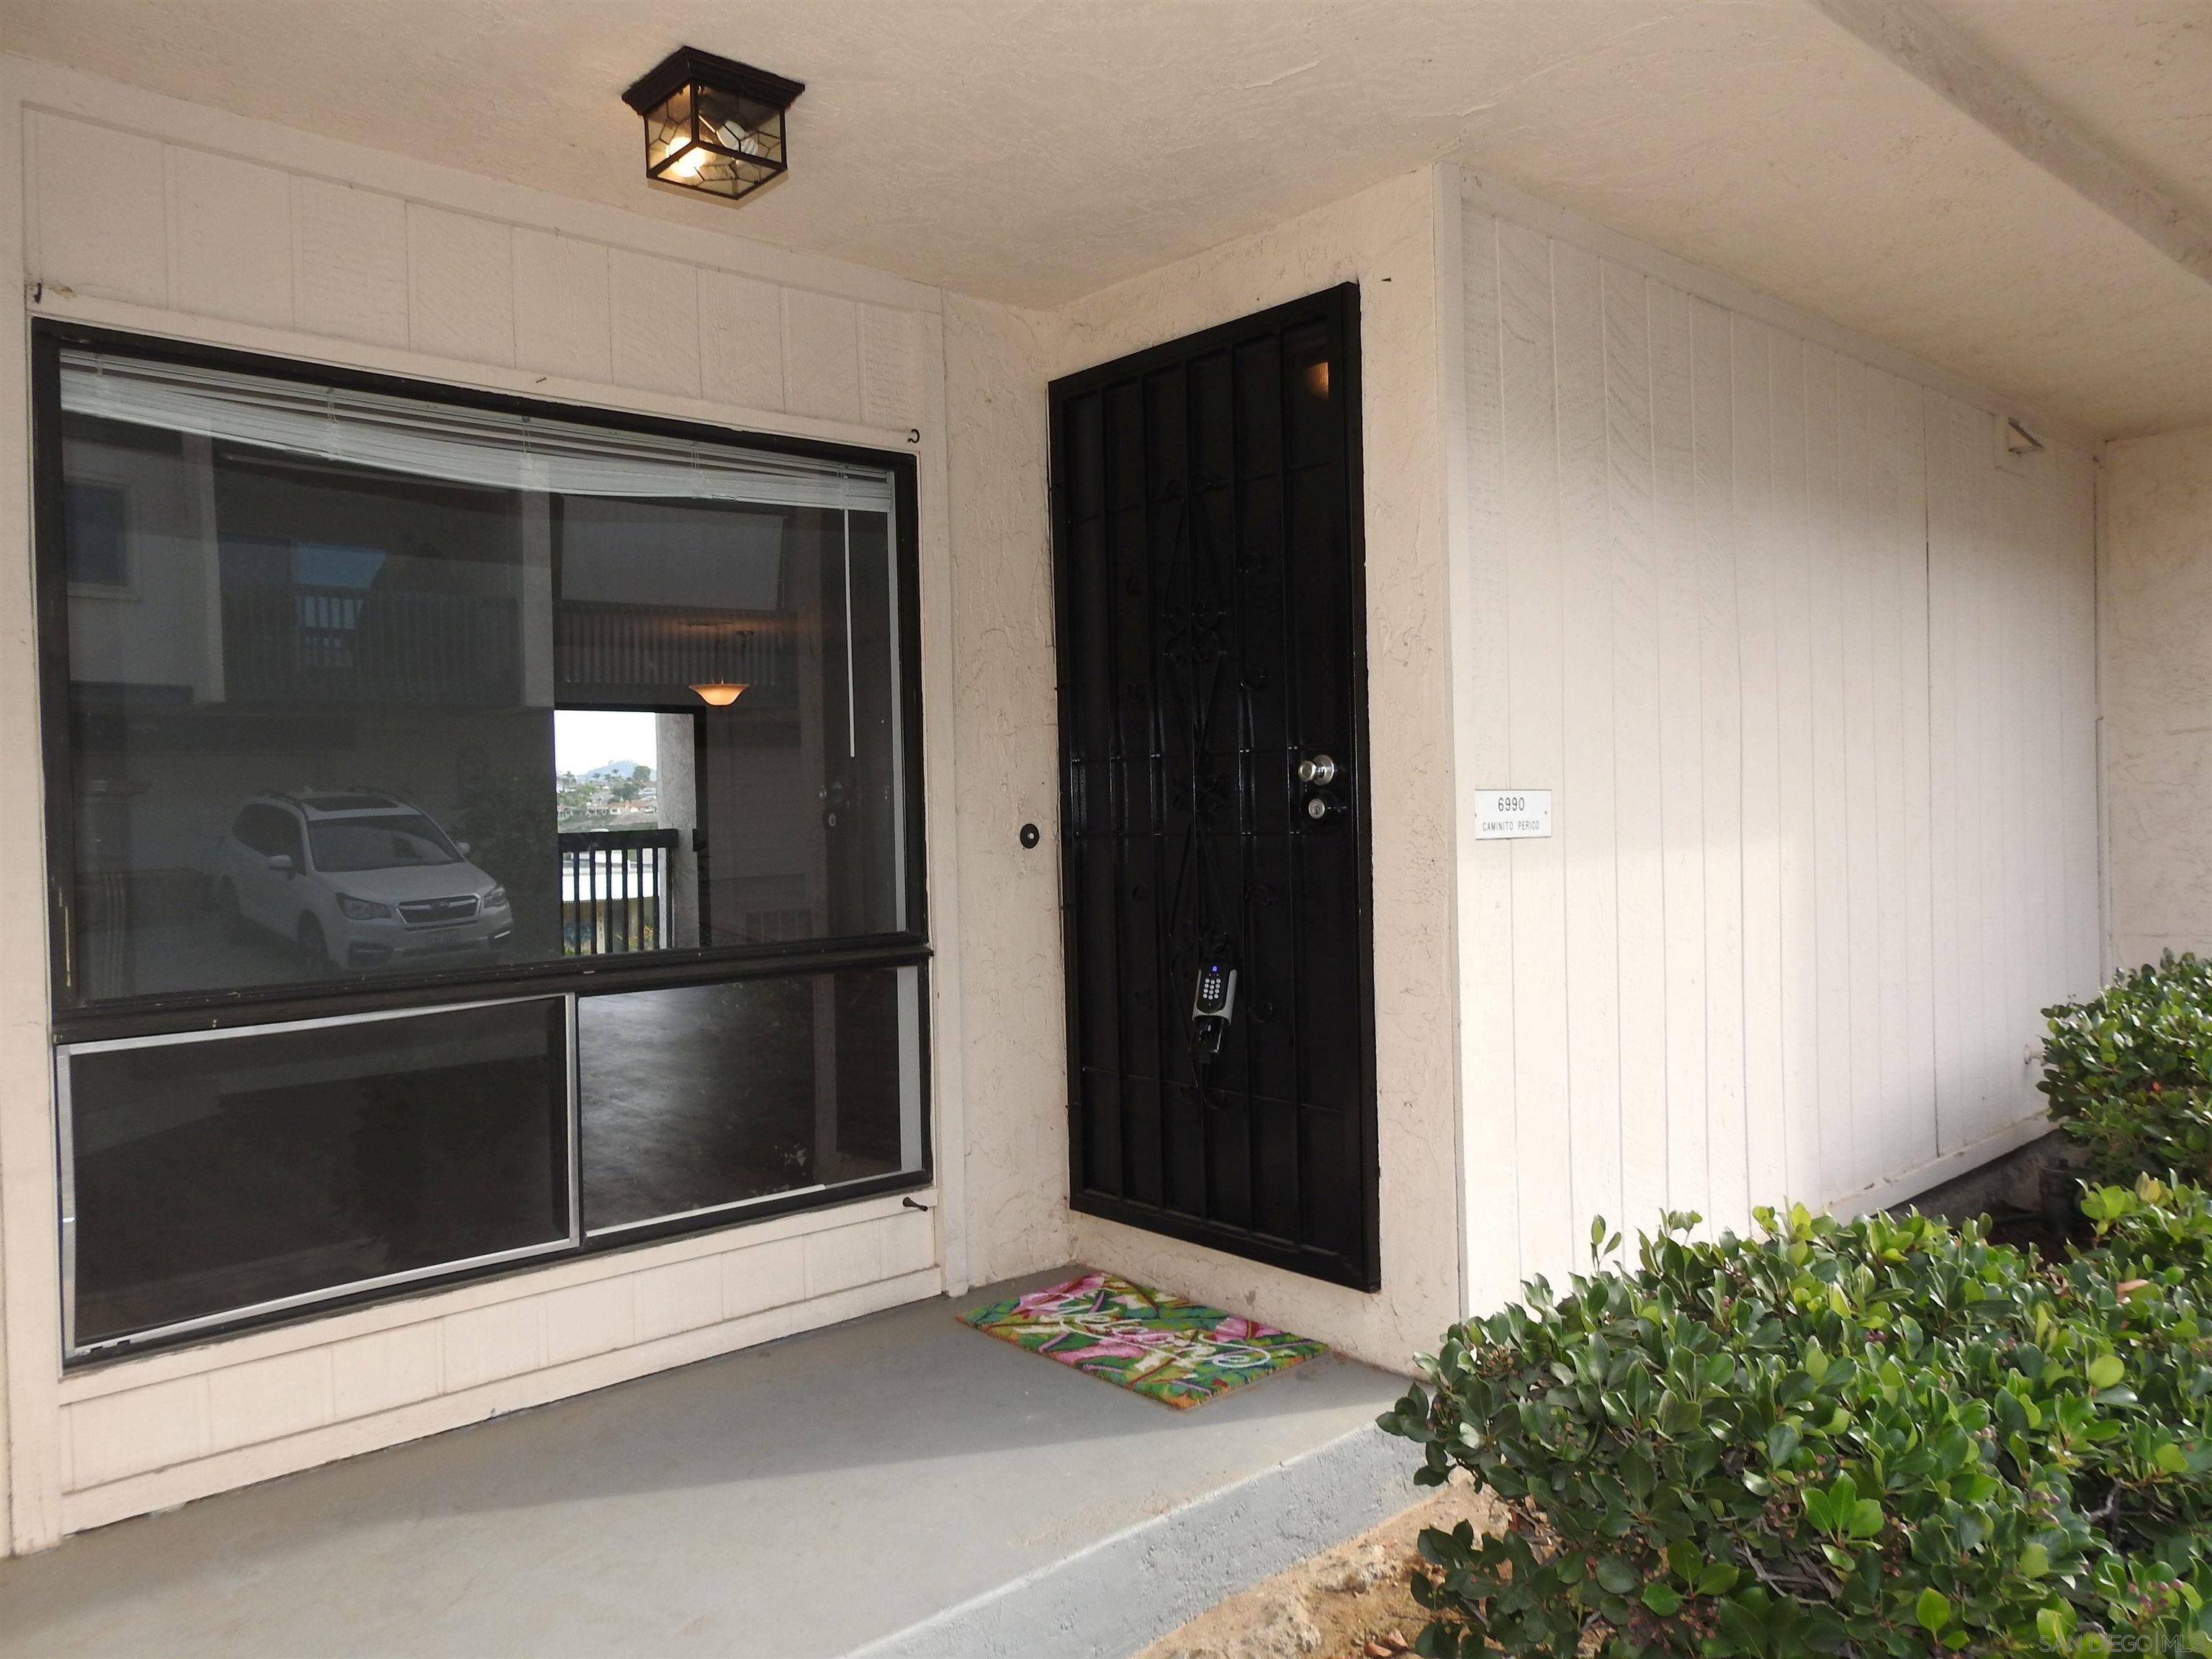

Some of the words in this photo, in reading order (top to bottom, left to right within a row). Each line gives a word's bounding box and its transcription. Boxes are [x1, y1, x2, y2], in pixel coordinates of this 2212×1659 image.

[1498, 797, 1525, 811] 6990
[1482, 821, 1514, 832] CAMINITO
[1518, 820, 1539, 830] PERICO
